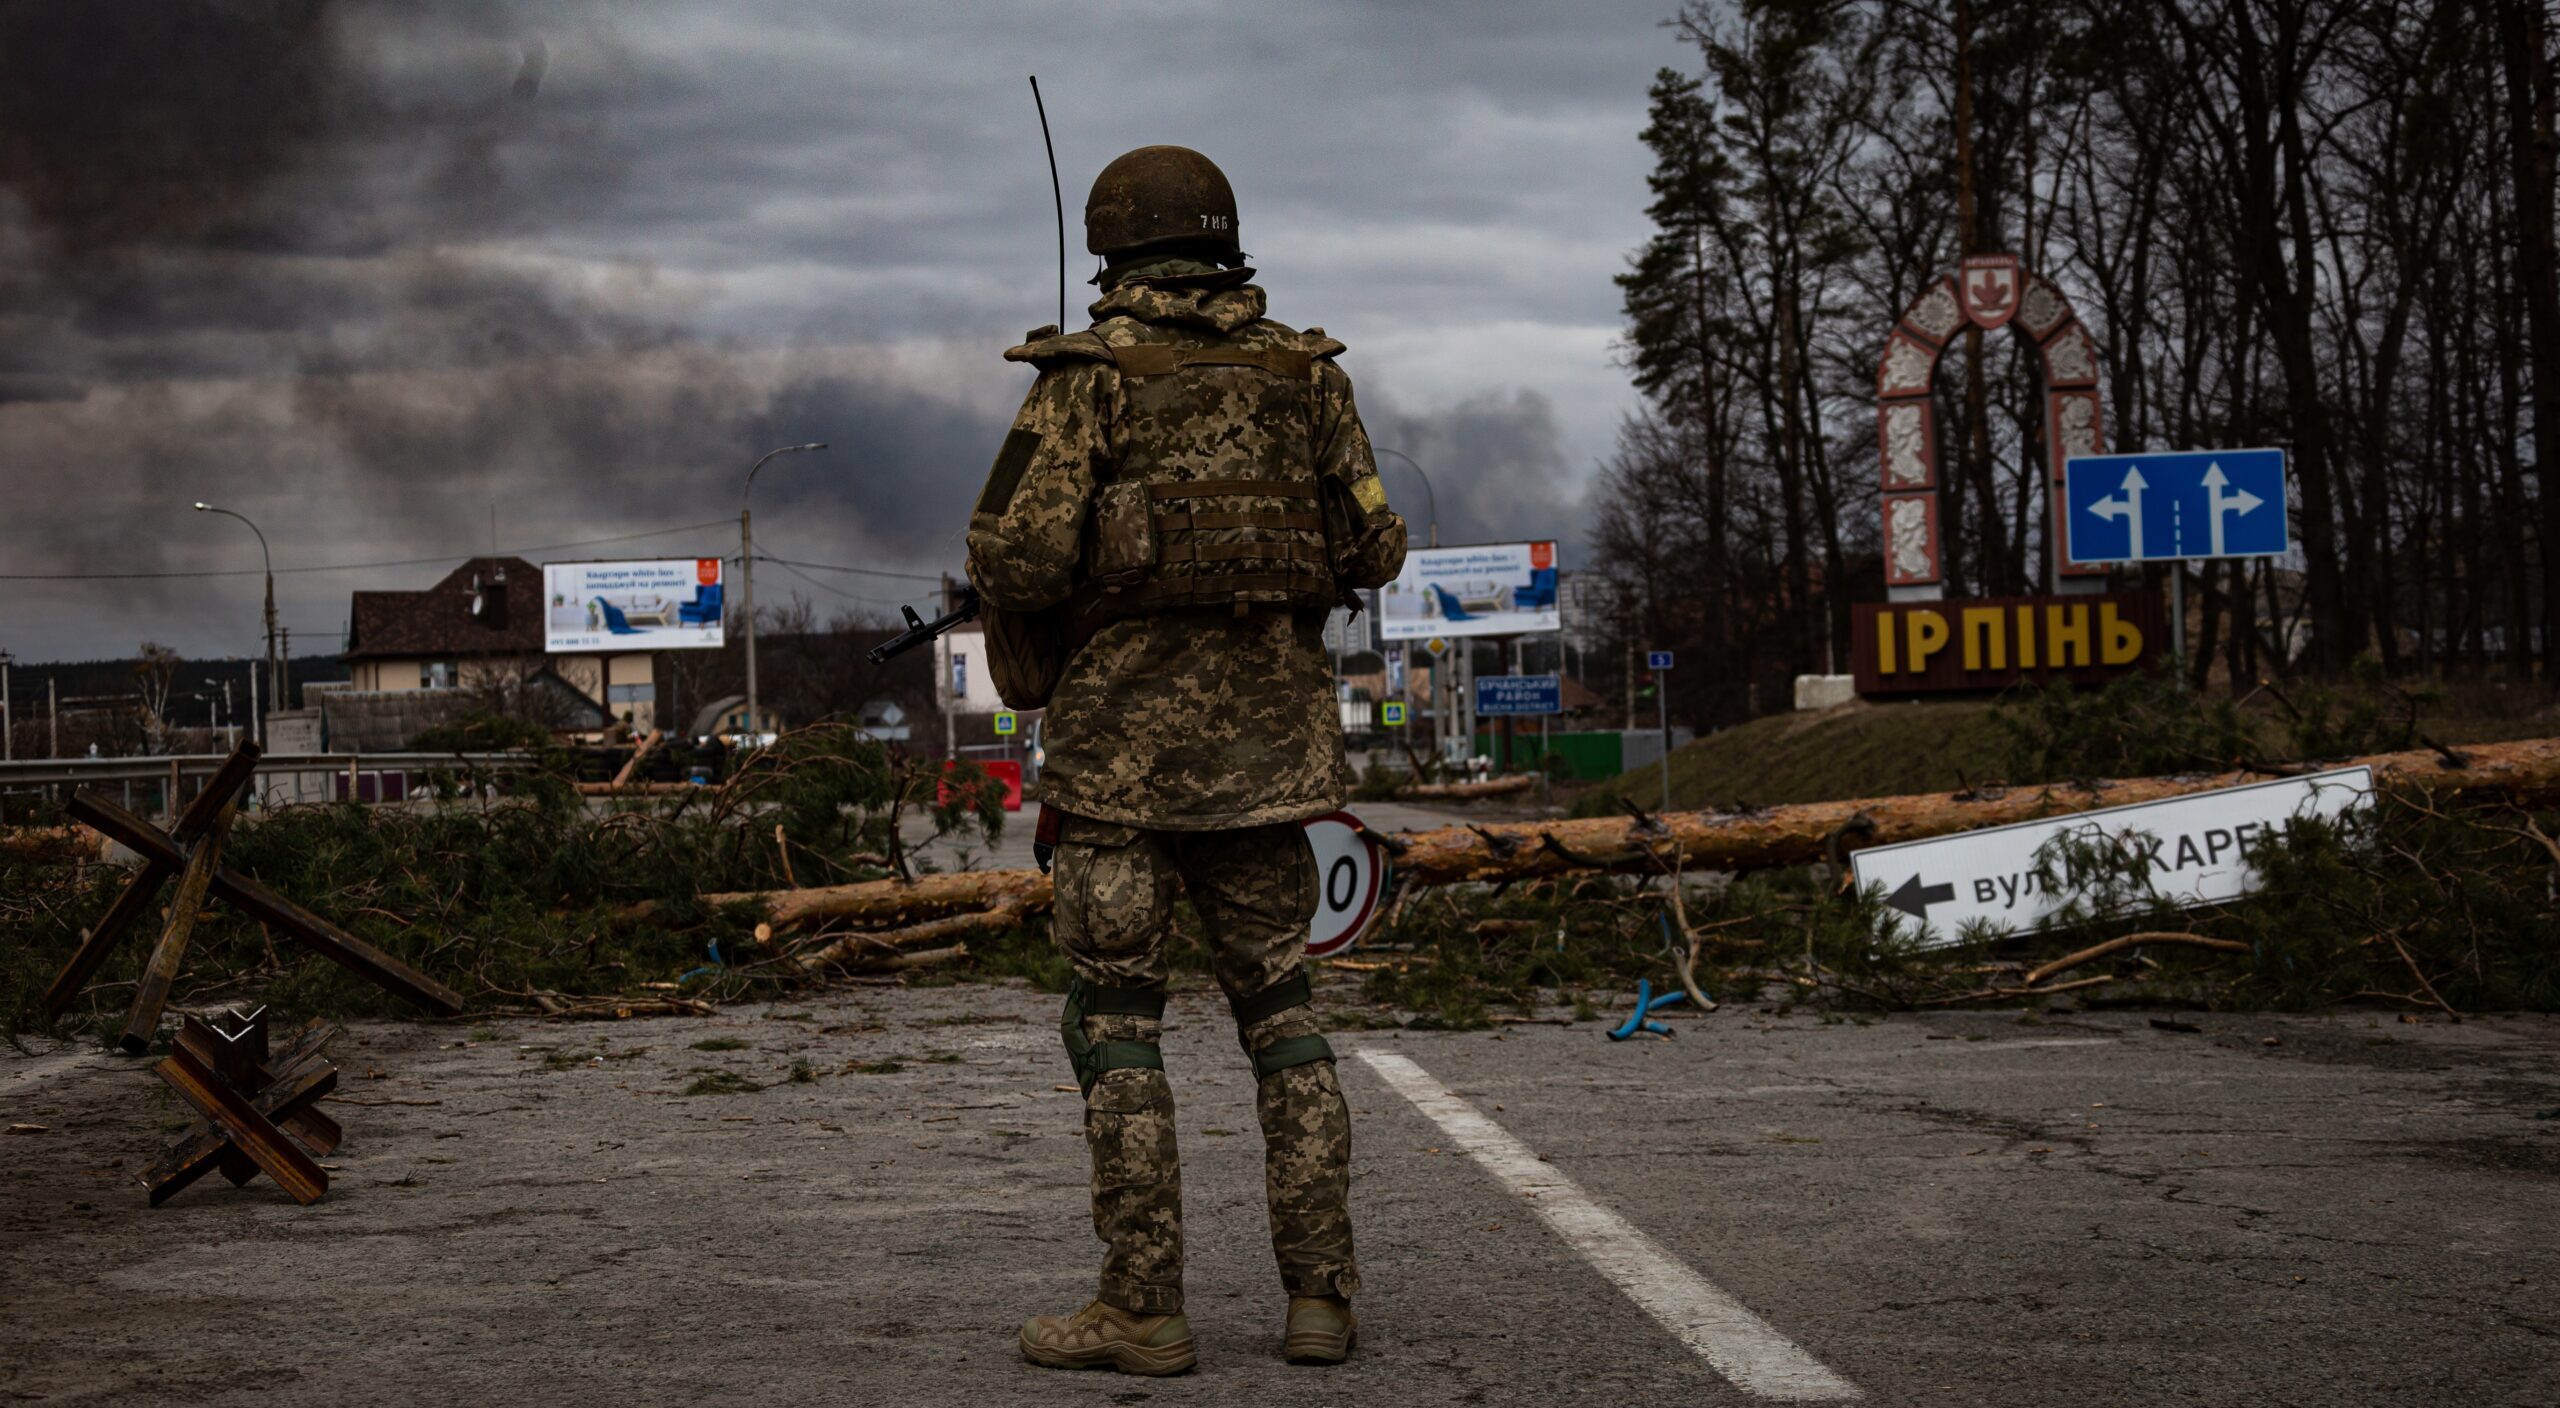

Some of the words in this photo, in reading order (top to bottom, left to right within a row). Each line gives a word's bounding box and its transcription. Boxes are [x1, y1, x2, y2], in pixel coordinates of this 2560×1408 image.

[1877, 602, 2143, 674] ІРПІНЬ
[1496, 689, 1541, 701] РАЙОН
[1327, 855, 1358, 912] 0
